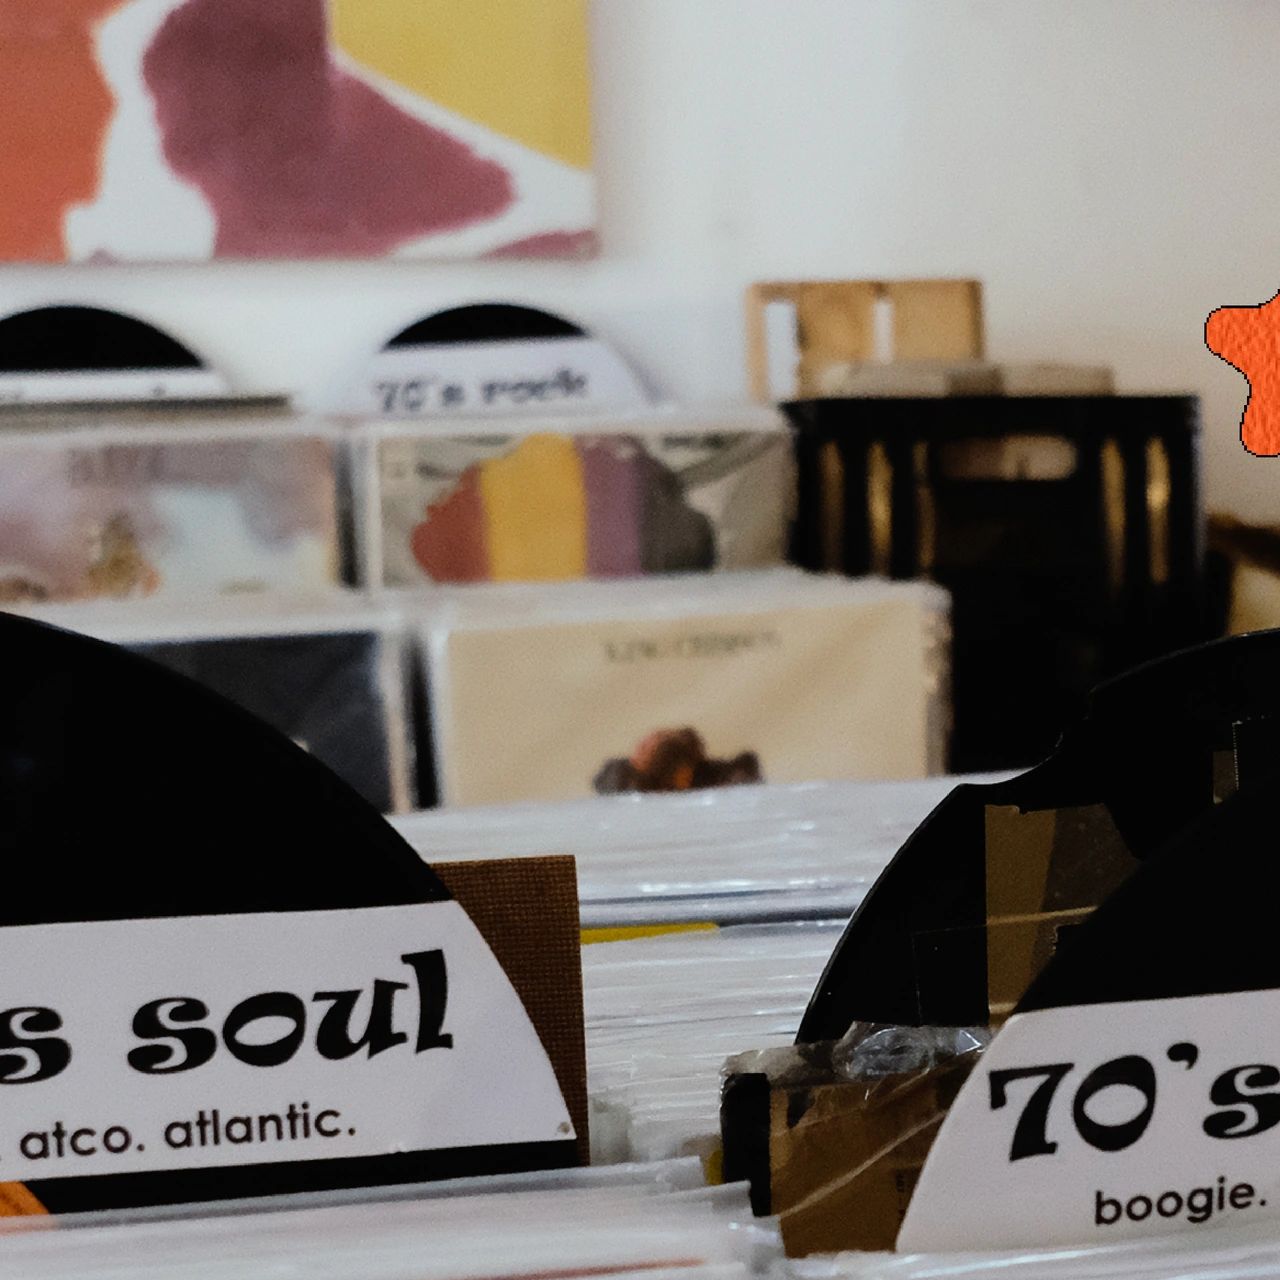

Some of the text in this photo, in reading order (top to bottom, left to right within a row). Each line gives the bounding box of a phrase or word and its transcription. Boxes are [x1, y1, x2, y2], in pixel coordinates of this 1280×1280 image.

[126, 948, 454, 1075] soul
[19, 1101, 356, 1161] atco. atlantic.
[1095, 1175, 1268, 1226] boogie.
